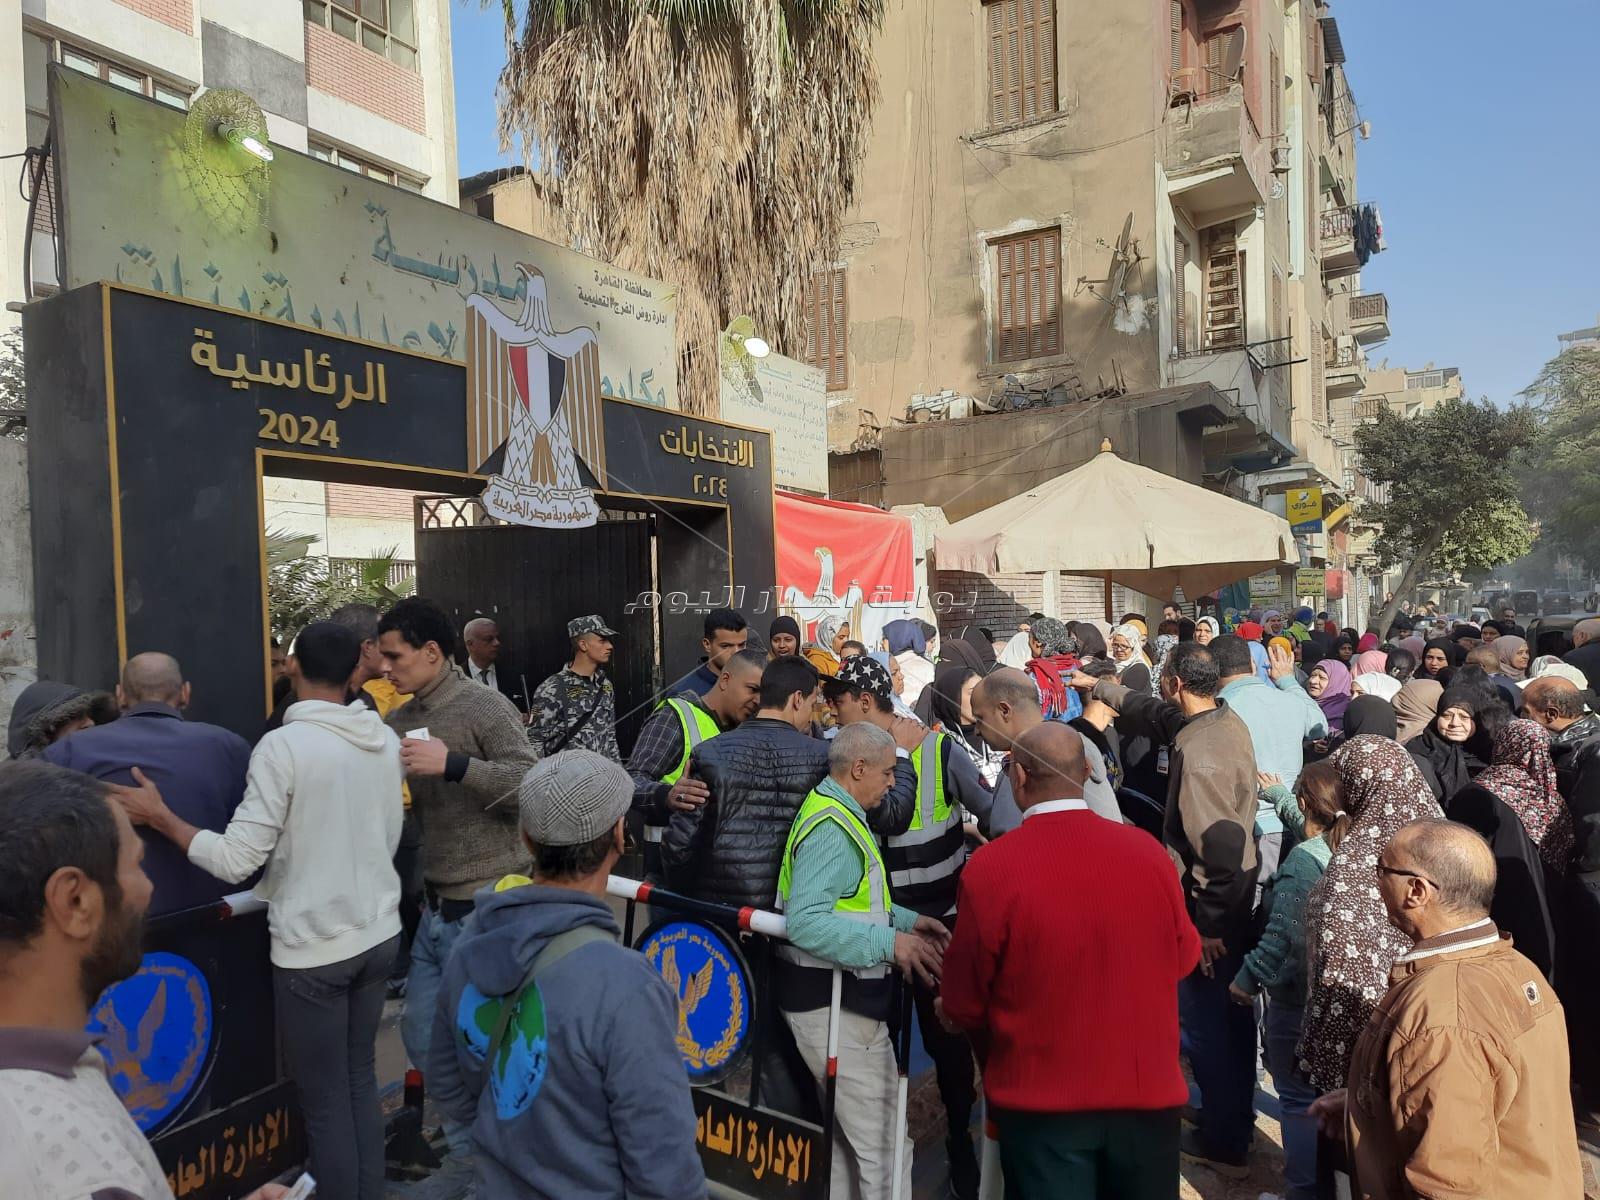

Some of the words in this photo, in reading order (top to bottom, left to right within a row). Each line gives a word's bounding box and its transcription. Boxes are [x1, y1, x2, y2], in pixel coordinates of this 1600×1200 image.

[594, 269, 623, 289] القاهرة
[624, 278, 652, 298] محافظة
[191, 328, 387, 410] الرئاسية
[258, 408, 340, 449] 2024
[660, 426, 754, 468] الانتخابات
[692, 474, 728, 497] ٢٠٢٤
[492, 490, 529, 518] العربية
[529, 508, 552, 522] مصر
[552, 502, 592, 523] جمهورية
[223, 1106, 290, 1179] الإدارة
[695, 1104, 743, 1160] العام
[748, 1120, 811, 1186] الإدارة
